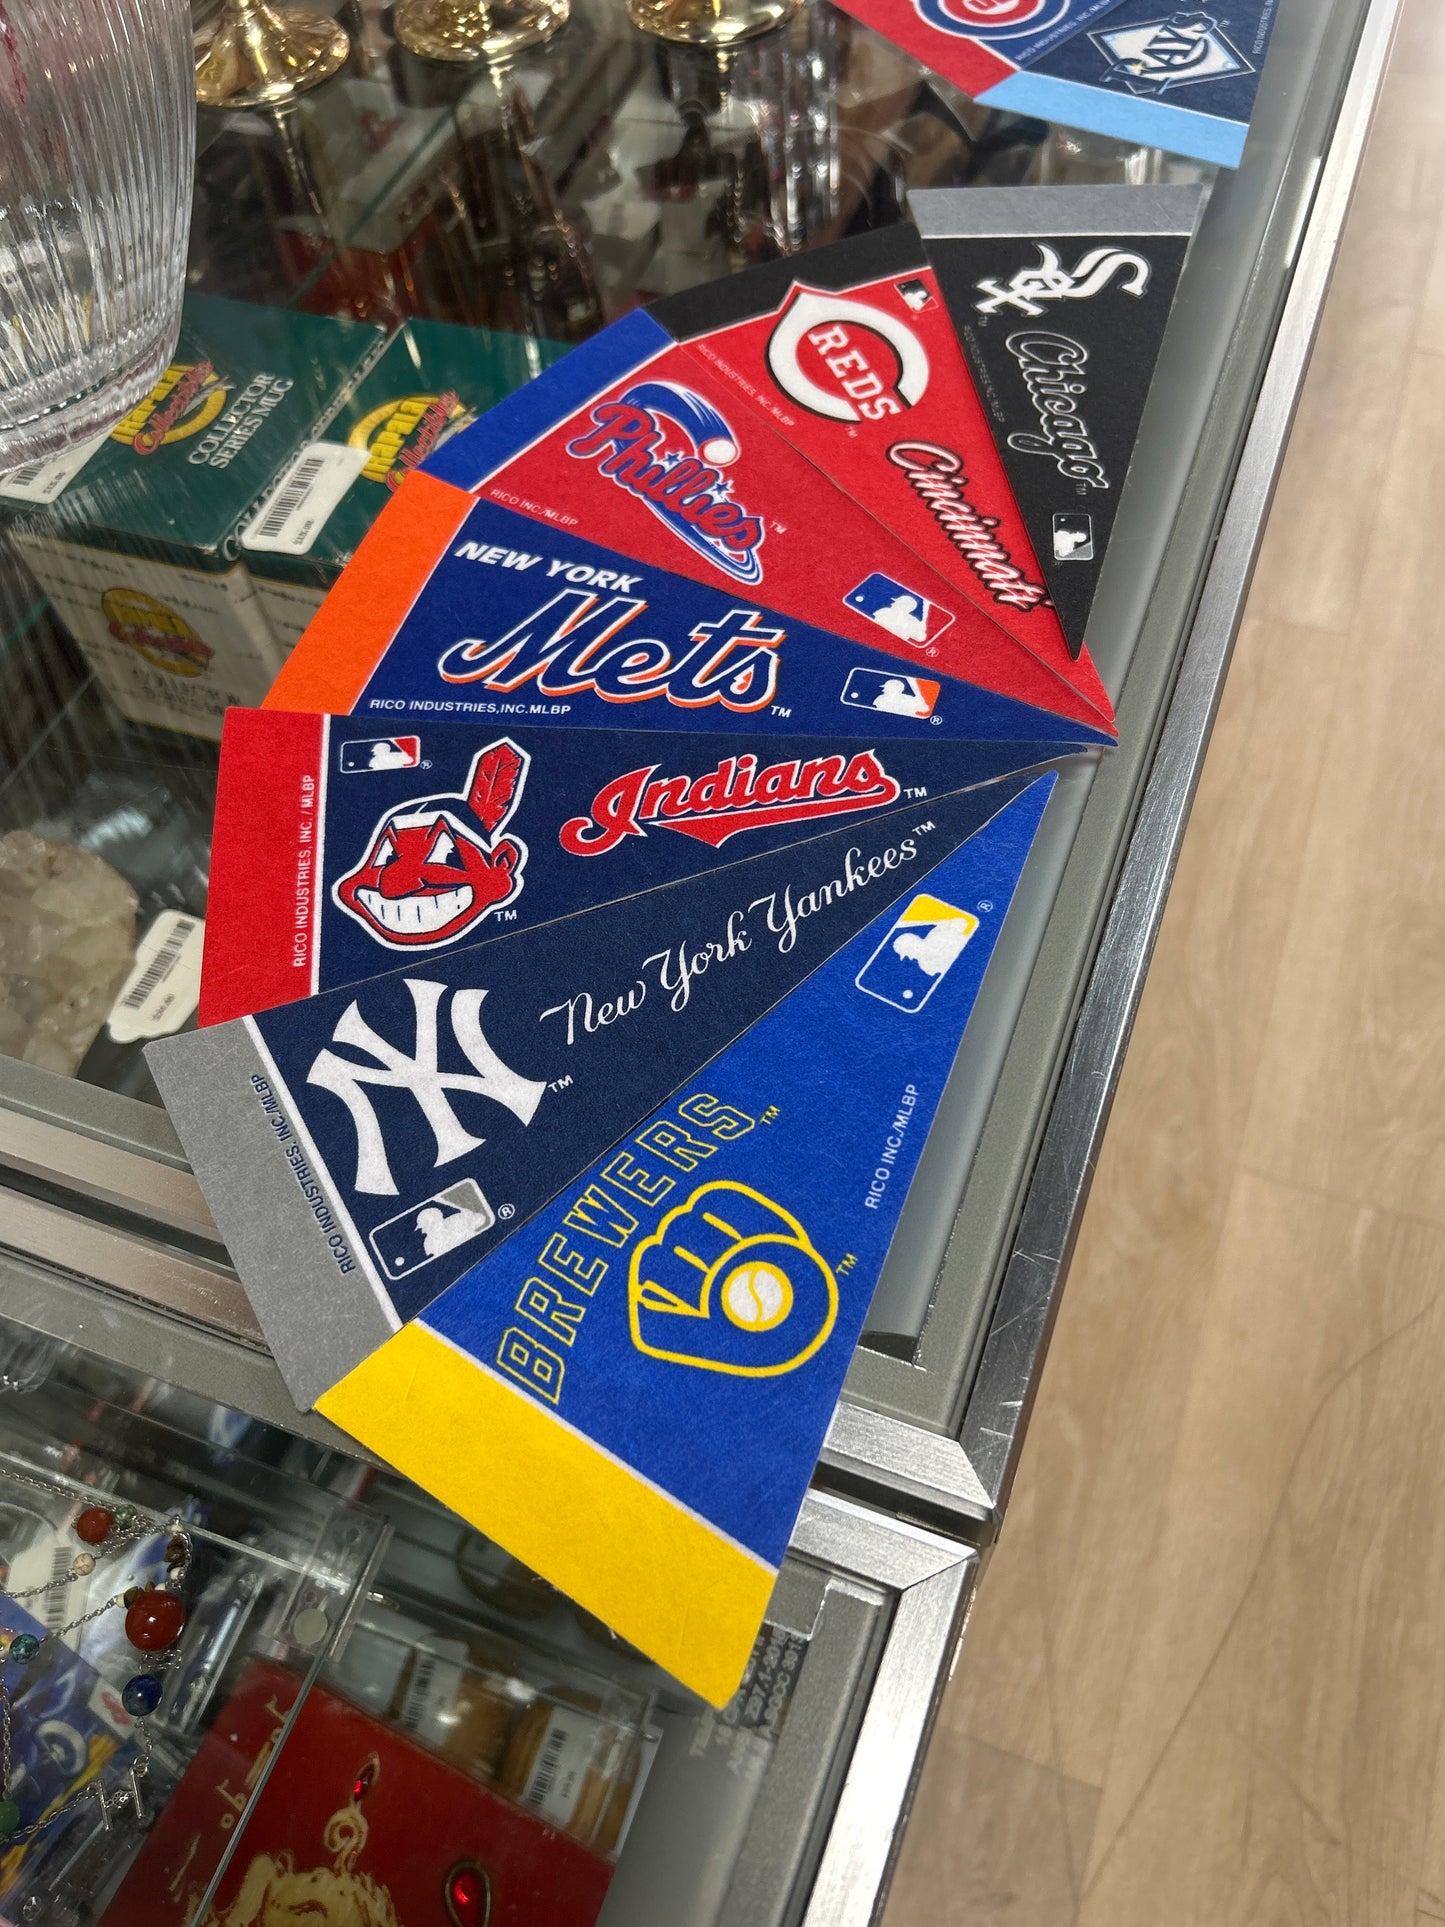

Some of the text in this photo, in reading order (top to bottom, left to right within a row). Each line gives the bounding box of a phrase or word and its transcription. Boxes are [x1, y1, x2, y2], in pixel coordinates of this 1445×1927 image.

[186, 371, 277, 466] COLLECTOR
[807, 325, 902, 421] REDS
[1005, 331, 1110, 489] Chicago
[208, 410, 267, 470] SERIES
[250, 377, 295, 422] MUG
[489, 488, 520, 506] RICO
[566, 401, 765, 553] Phillies
[453, 541, 645, 595] NEW YORK
[437, 588, 790, 714] Mets
[369, 698, 406, 711] RICO
[300, 819, 314, 844] INC.
[301, 774, 317, 808] MLBP
[559, 748, 901, 857] Indians
[295, 843, 314, 933] INDUSTRIES,
[292, 931, 309, 968] RICO
[538, 838, 919, 1046] New York Yankees
[250, 1072, 295, 1144] INC./MLBP
[306, 978, 548, 1196] NY
[864, 1083, 918, 1210] RICO INC./MLBP
[328, 1231, 356, 1276] RICO
[496, 1092, 757, 1406] BREWERS
